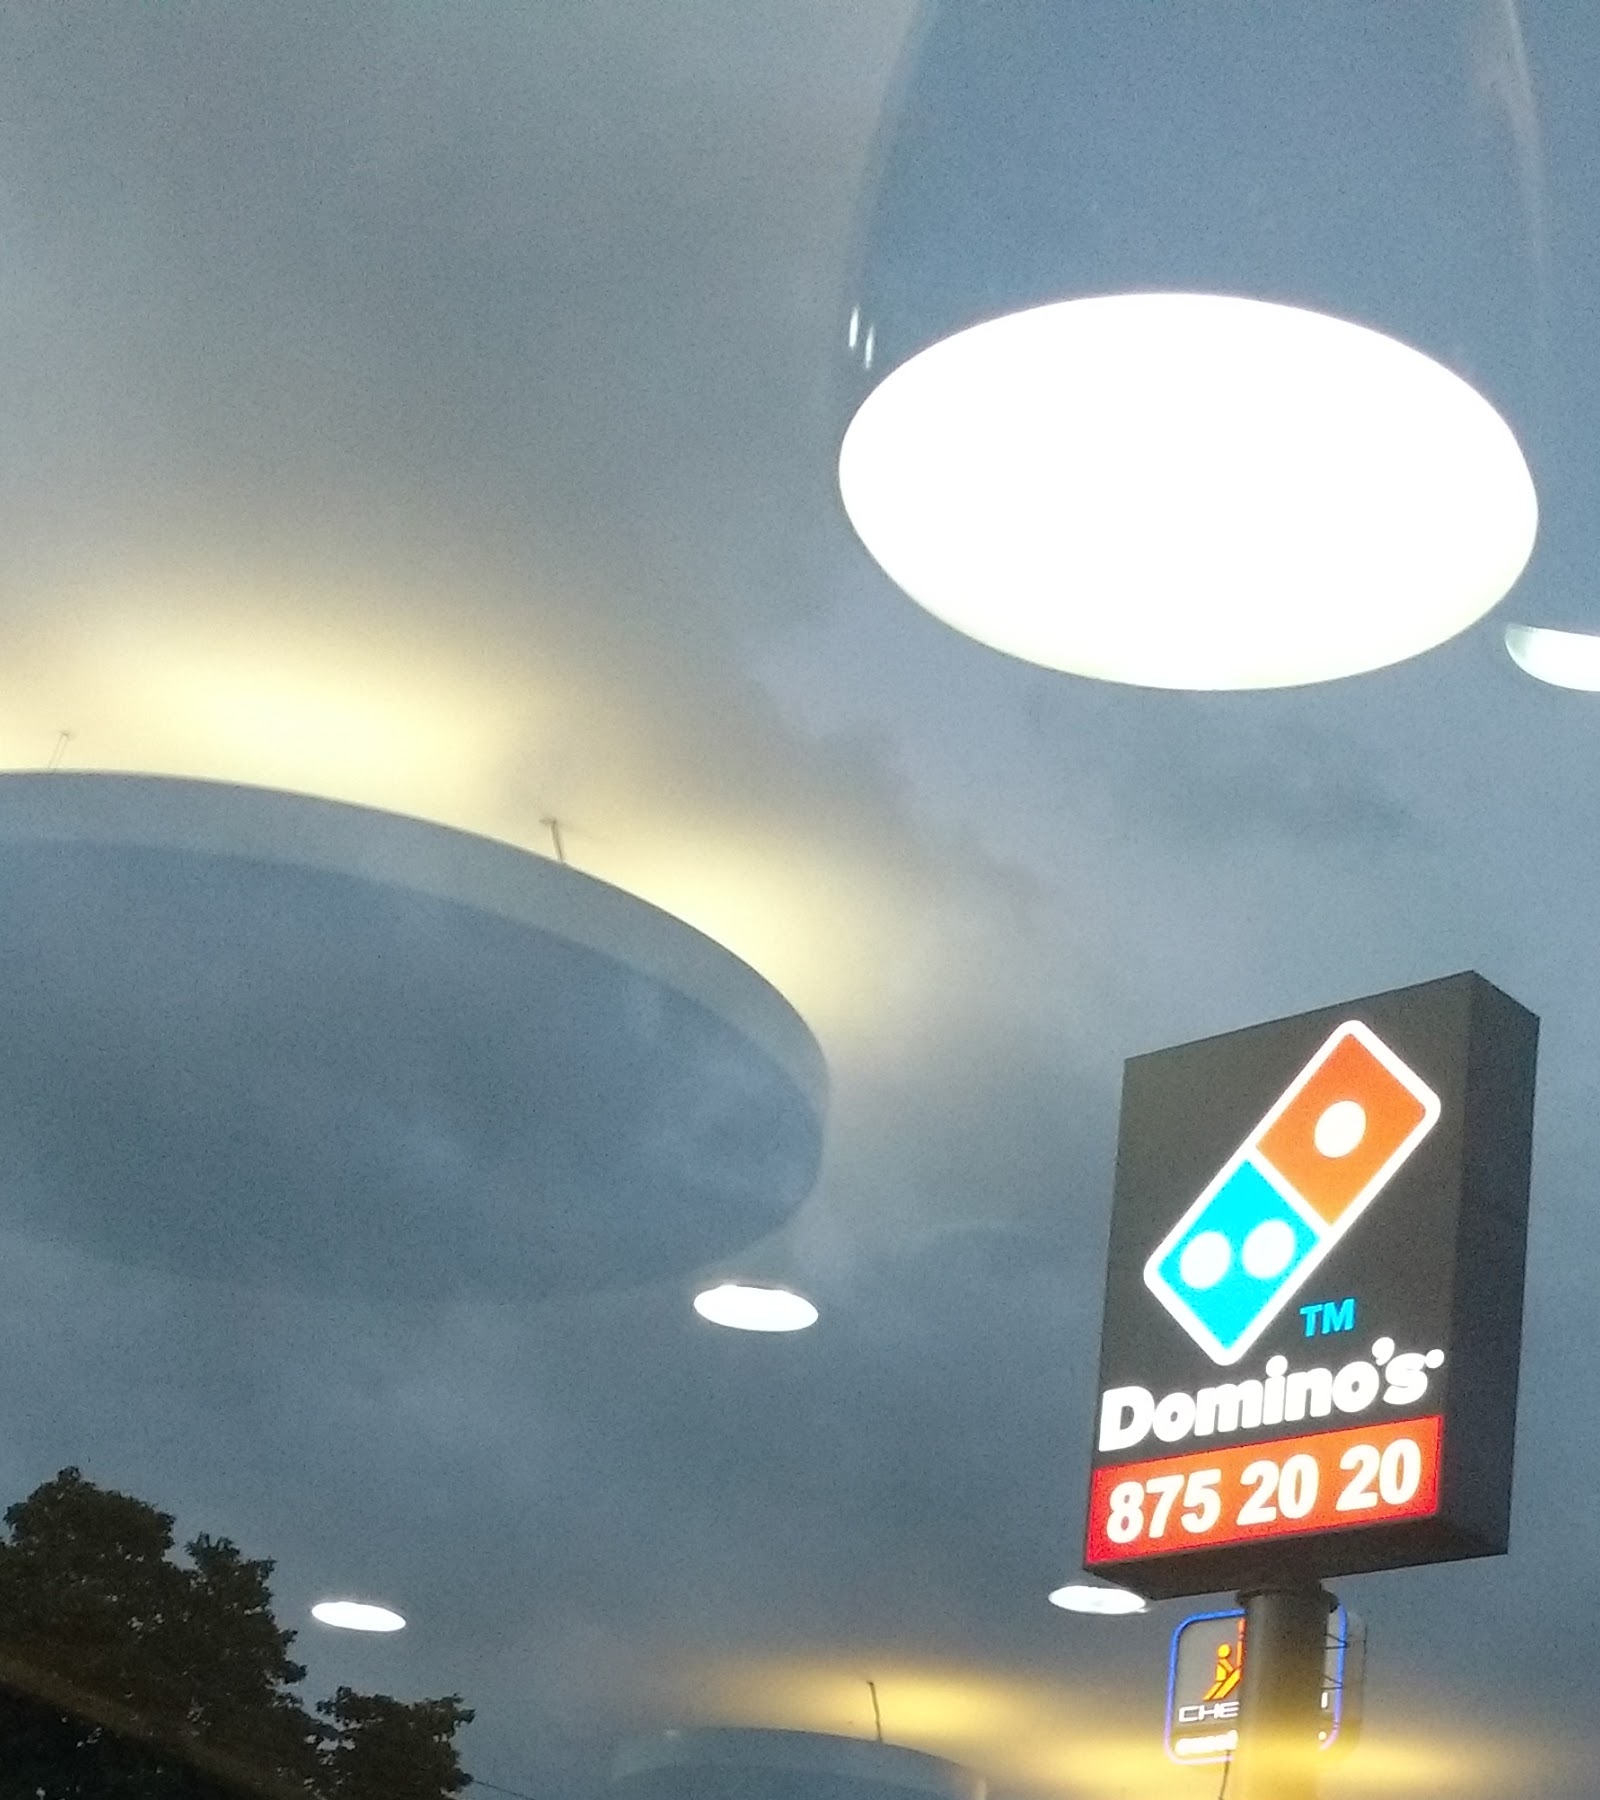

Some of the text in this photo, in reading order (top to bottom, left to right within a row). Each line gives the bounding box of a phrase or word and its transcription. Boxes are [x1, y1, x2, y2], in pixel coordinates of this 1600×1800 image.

[1300, 1298, 1357, 1337] TM
[1099, 1336, 1430, 1452] Domino's
[1105, 1438, 1421, 1544] 875 20 20
